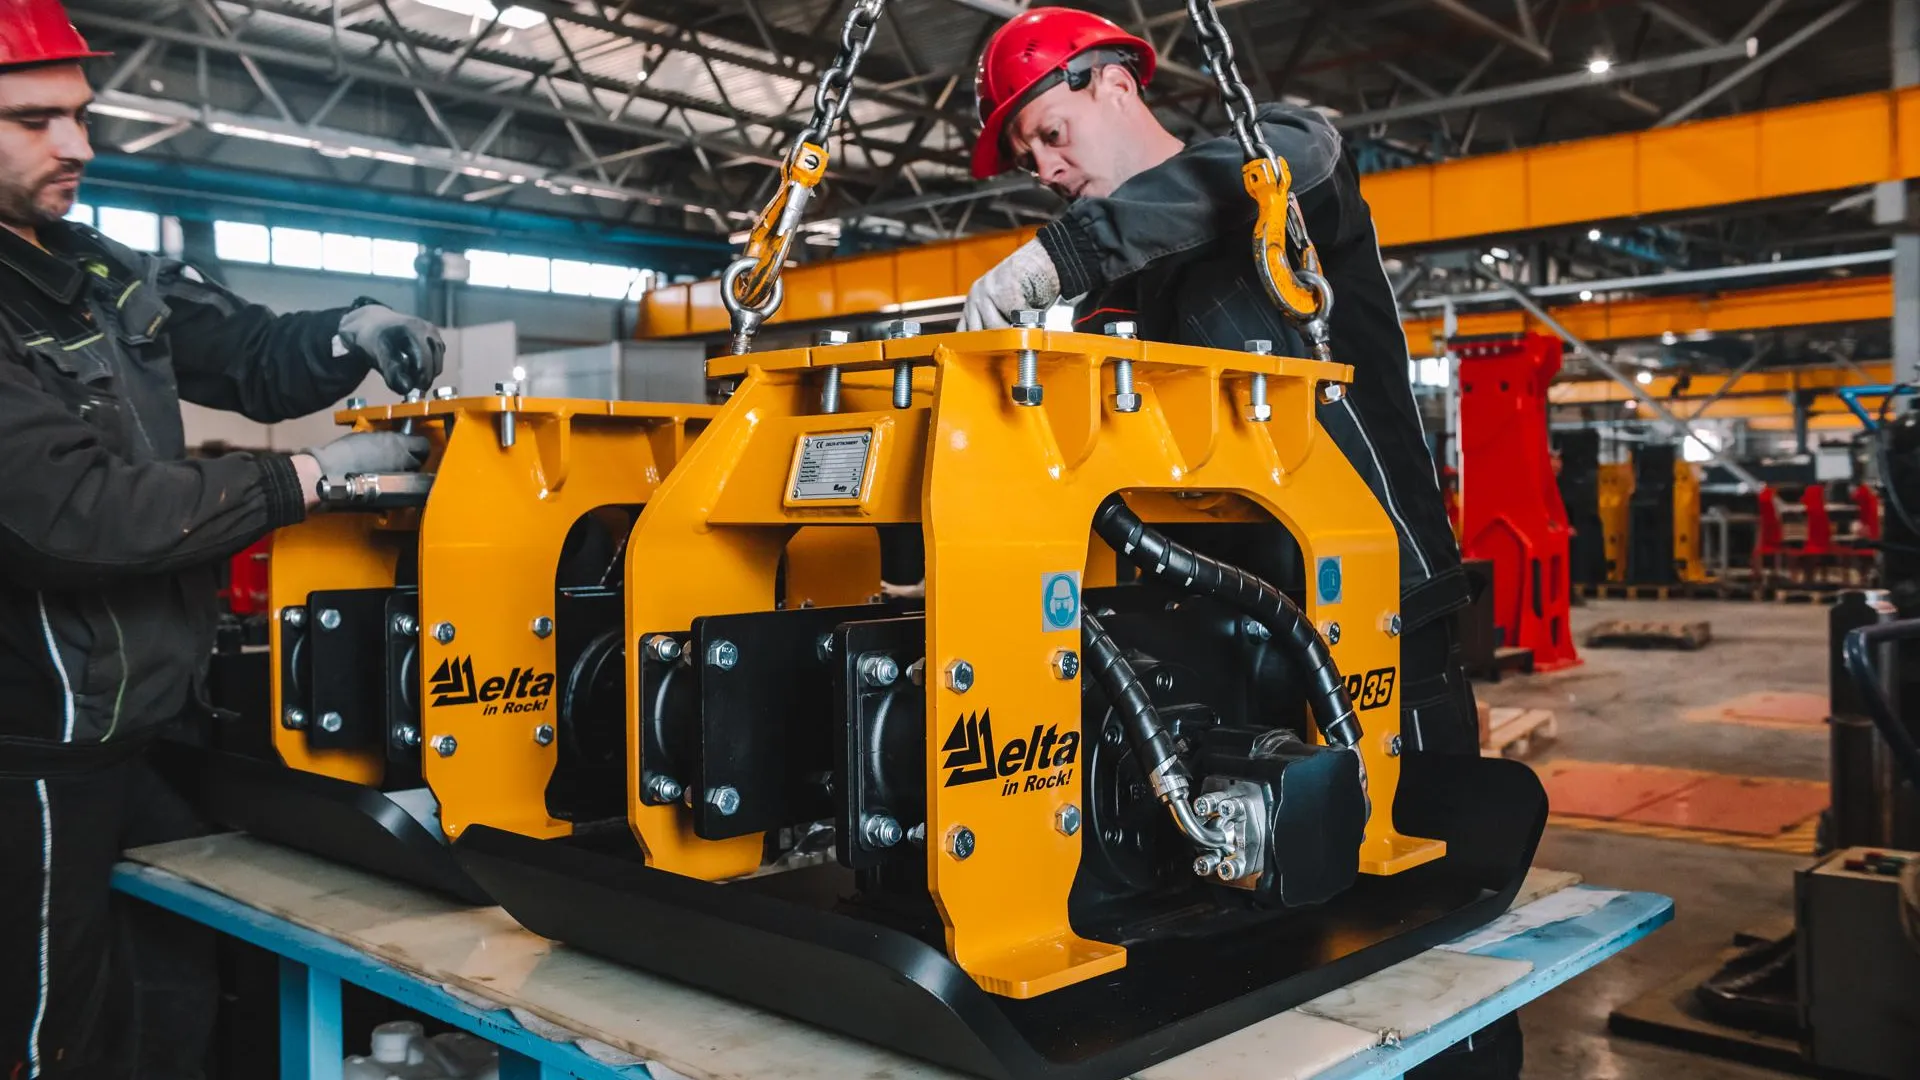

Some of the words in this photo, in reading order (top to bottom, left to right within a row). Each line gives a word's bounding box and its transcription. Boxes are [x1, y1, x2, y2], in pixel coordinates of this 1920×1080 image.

[483, 704, 498, 716] in
[502, 699, 548, 714] Rock!
[1001, 779, 1019, 796] in
[1023, 768, 1073, 792] Rock!
